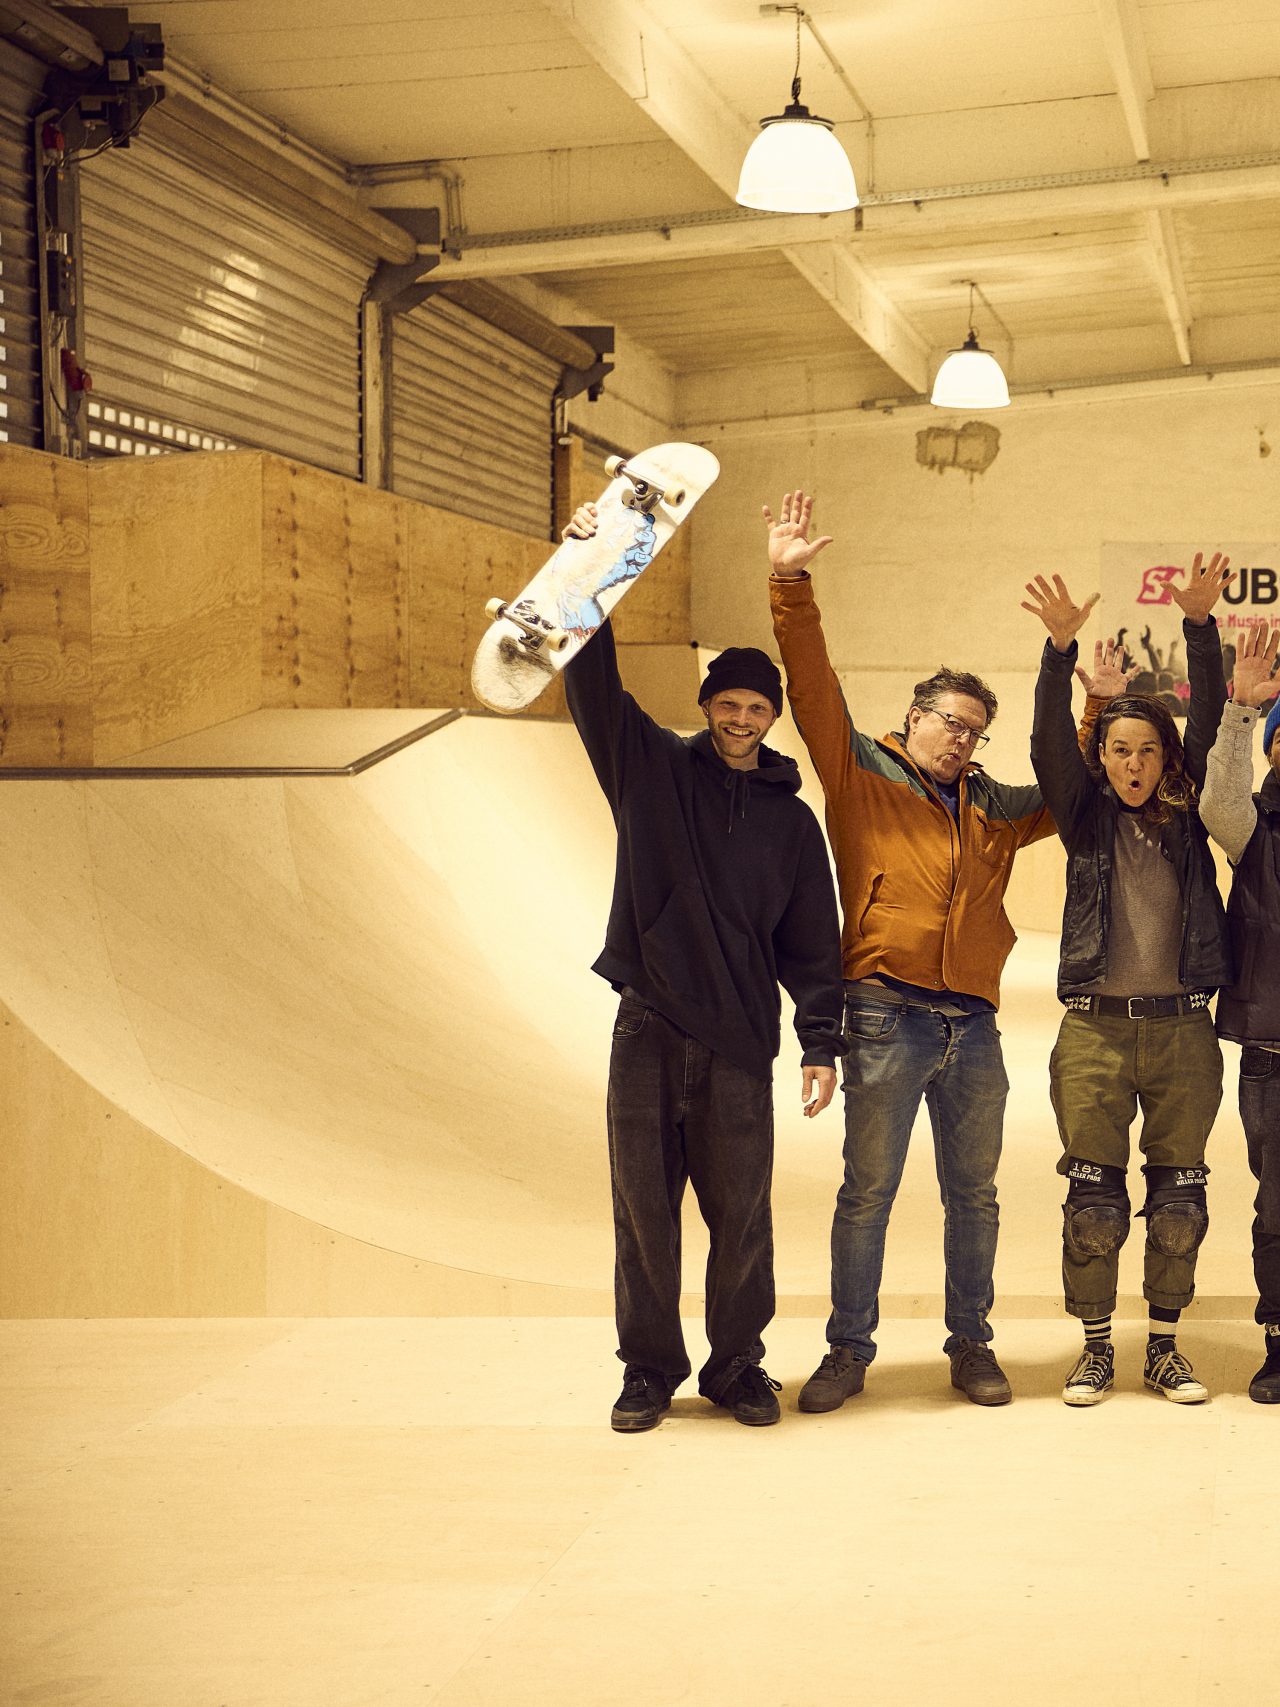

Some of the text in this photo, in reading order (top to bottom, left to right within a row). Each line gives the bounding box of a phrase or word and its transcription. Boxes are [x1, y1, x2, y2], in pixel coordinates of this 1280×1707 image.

[1072, 1162, 1102, 1176] 187
[1068, 1171, 1087, 1179] KILLER
[1177, 1170, 1203, 1180] 187
